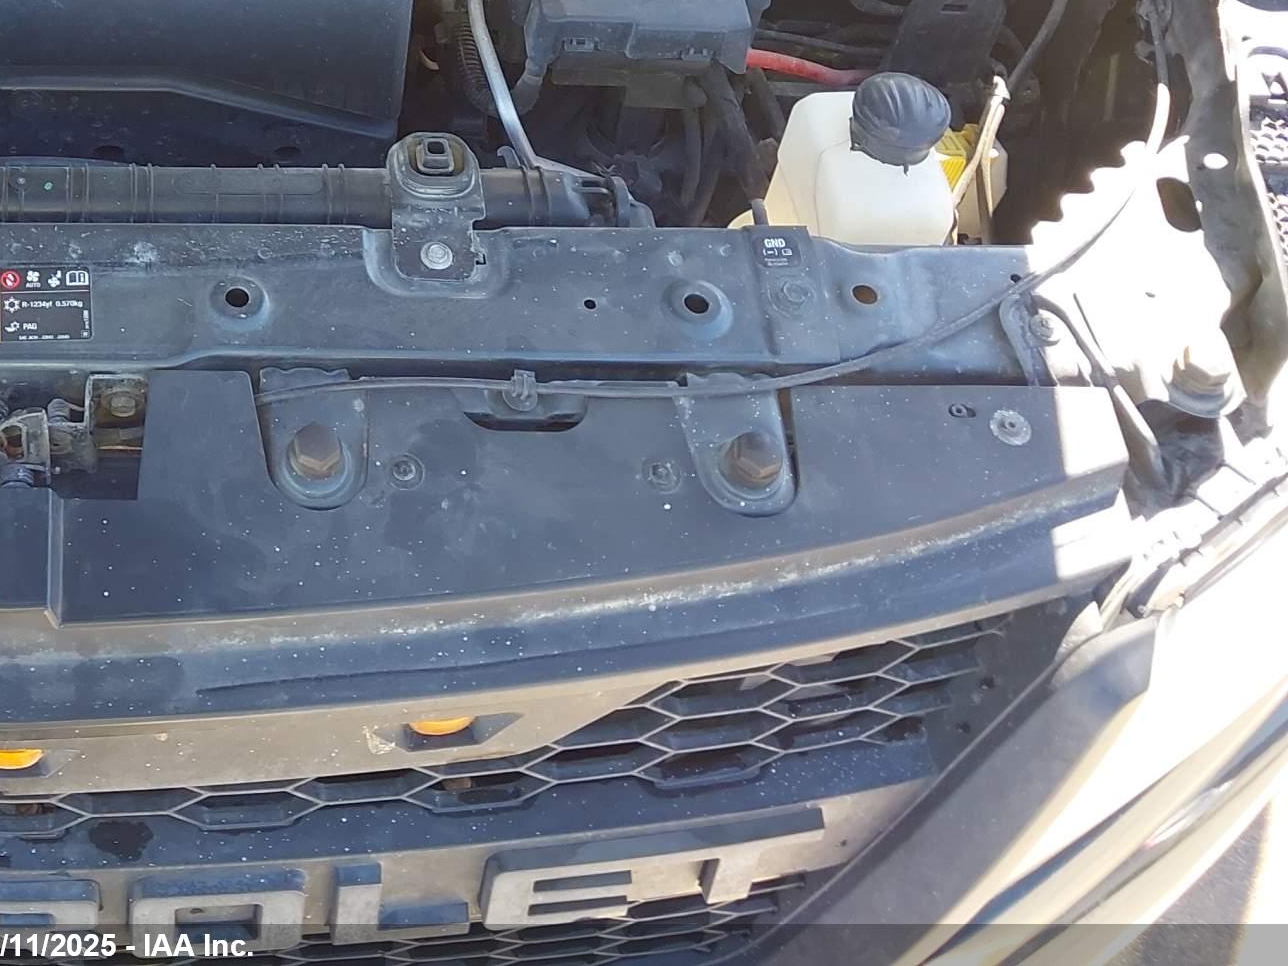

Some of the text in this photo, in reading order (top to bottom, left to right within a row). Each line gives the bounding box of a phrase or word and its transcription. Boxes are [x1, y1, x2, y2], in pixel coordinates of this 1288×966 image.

[764, 238, 785, 248] GND
[21, 300, 53, 309] R-1234yf
[22, 322, 38, 330] PAG
